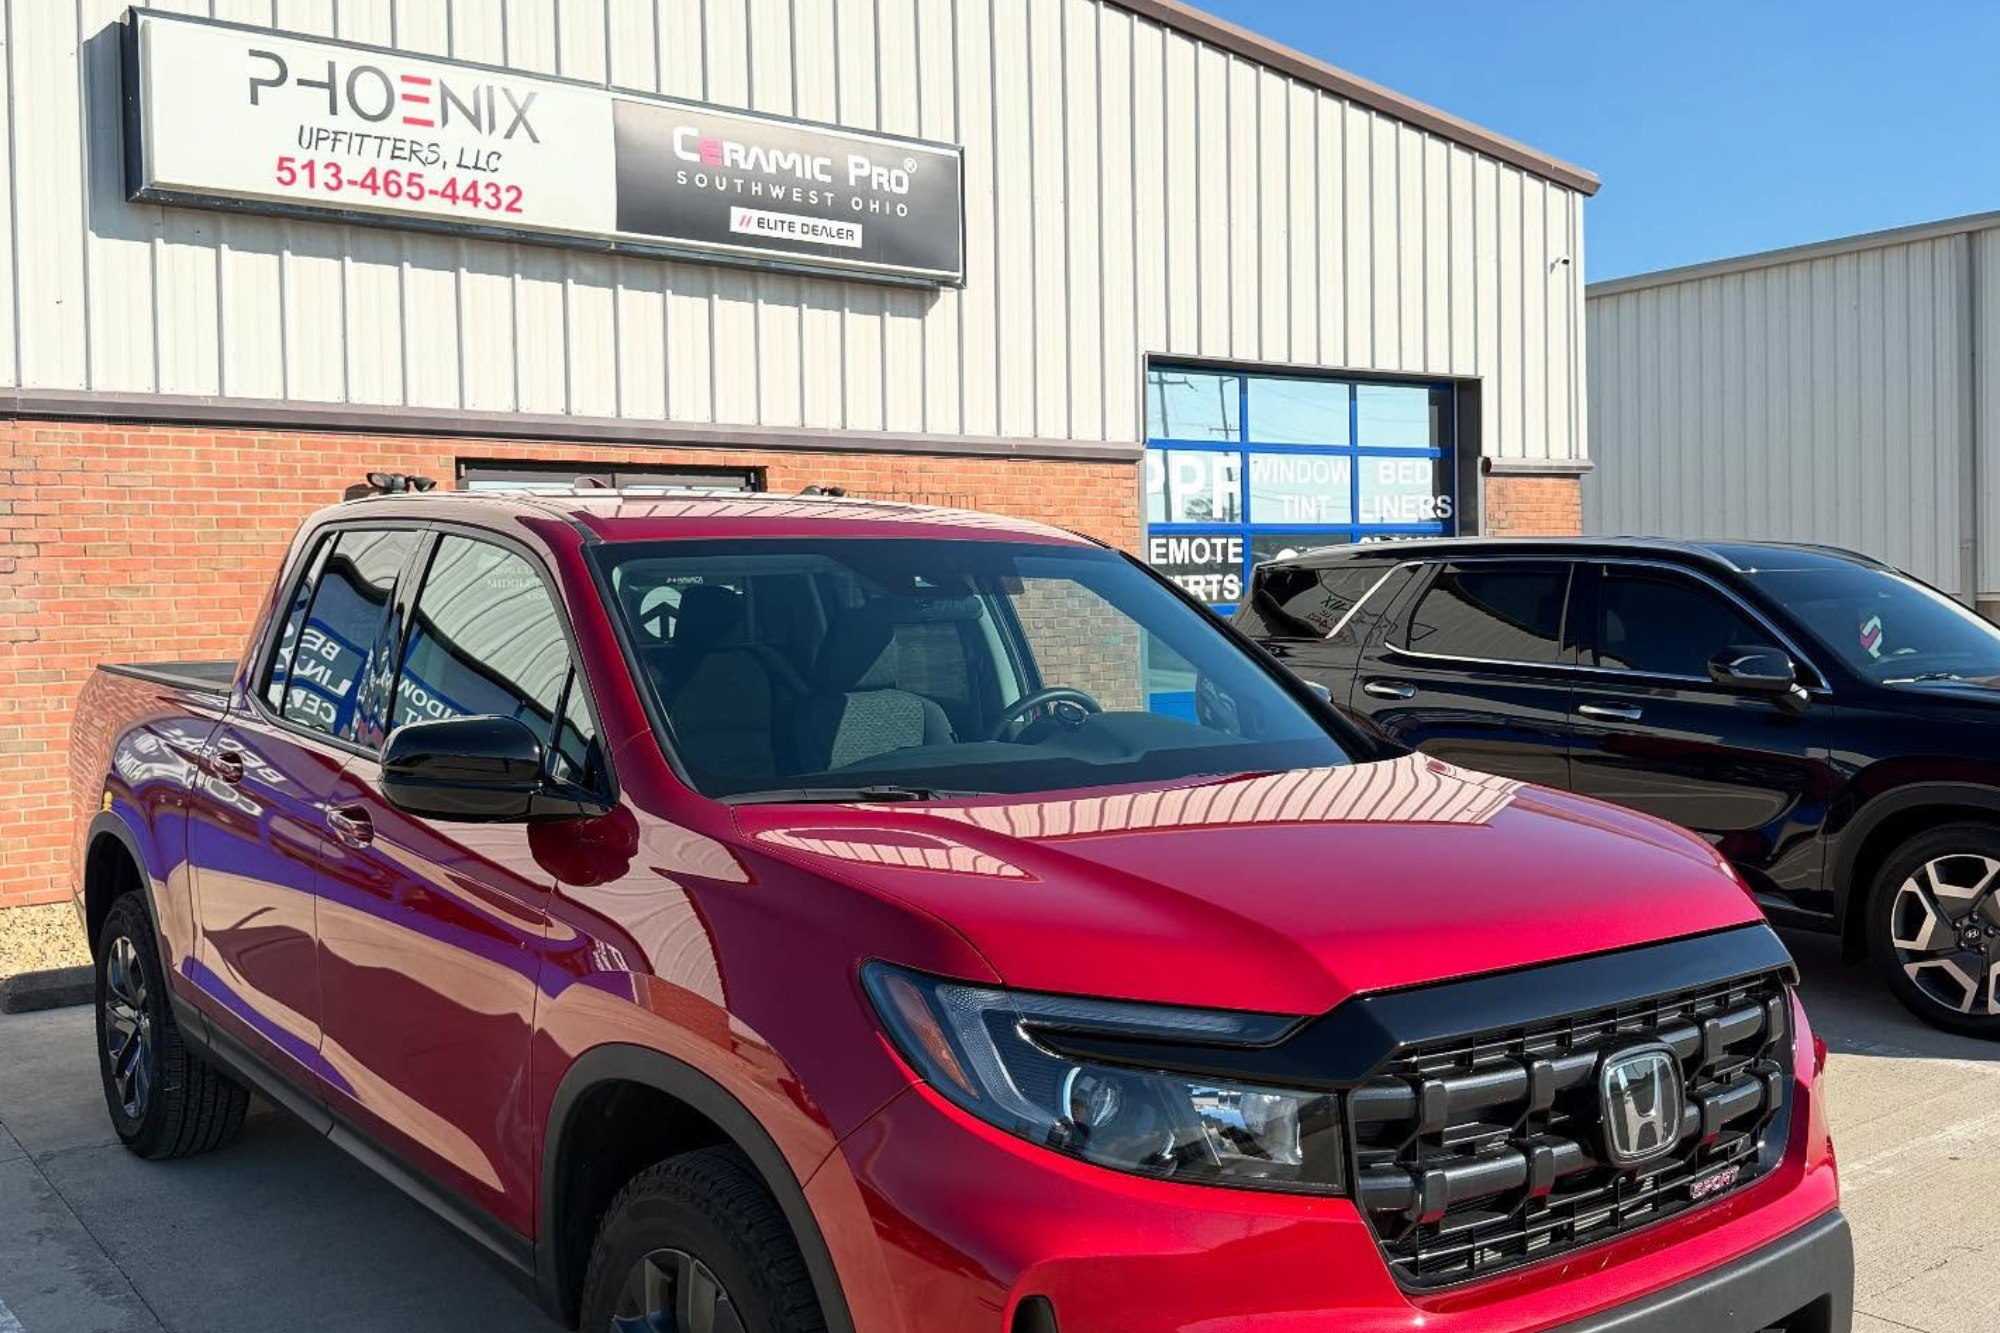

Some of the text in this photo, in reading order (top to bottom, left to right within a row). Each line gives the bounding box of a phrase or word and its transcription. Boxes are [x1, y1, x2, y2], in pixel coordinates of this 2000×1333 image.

[248, 49, 540, 143] PHOENIX
[298, 124, 502, 173] UPFITTERS, LLC
[276, 155, 524, 213] 513-465-4432
[676, 170, 909, 217] SOUTHWEST OHIO
[756, 216, 855, 241] ELITE DEALER
[1252, 458, 1350, 485] WINDOW
[1378, 461, 1432, 485] BED
[1279, 495, 1332, 521] TINT
[1359, 495, 1453, 520] LINERS
